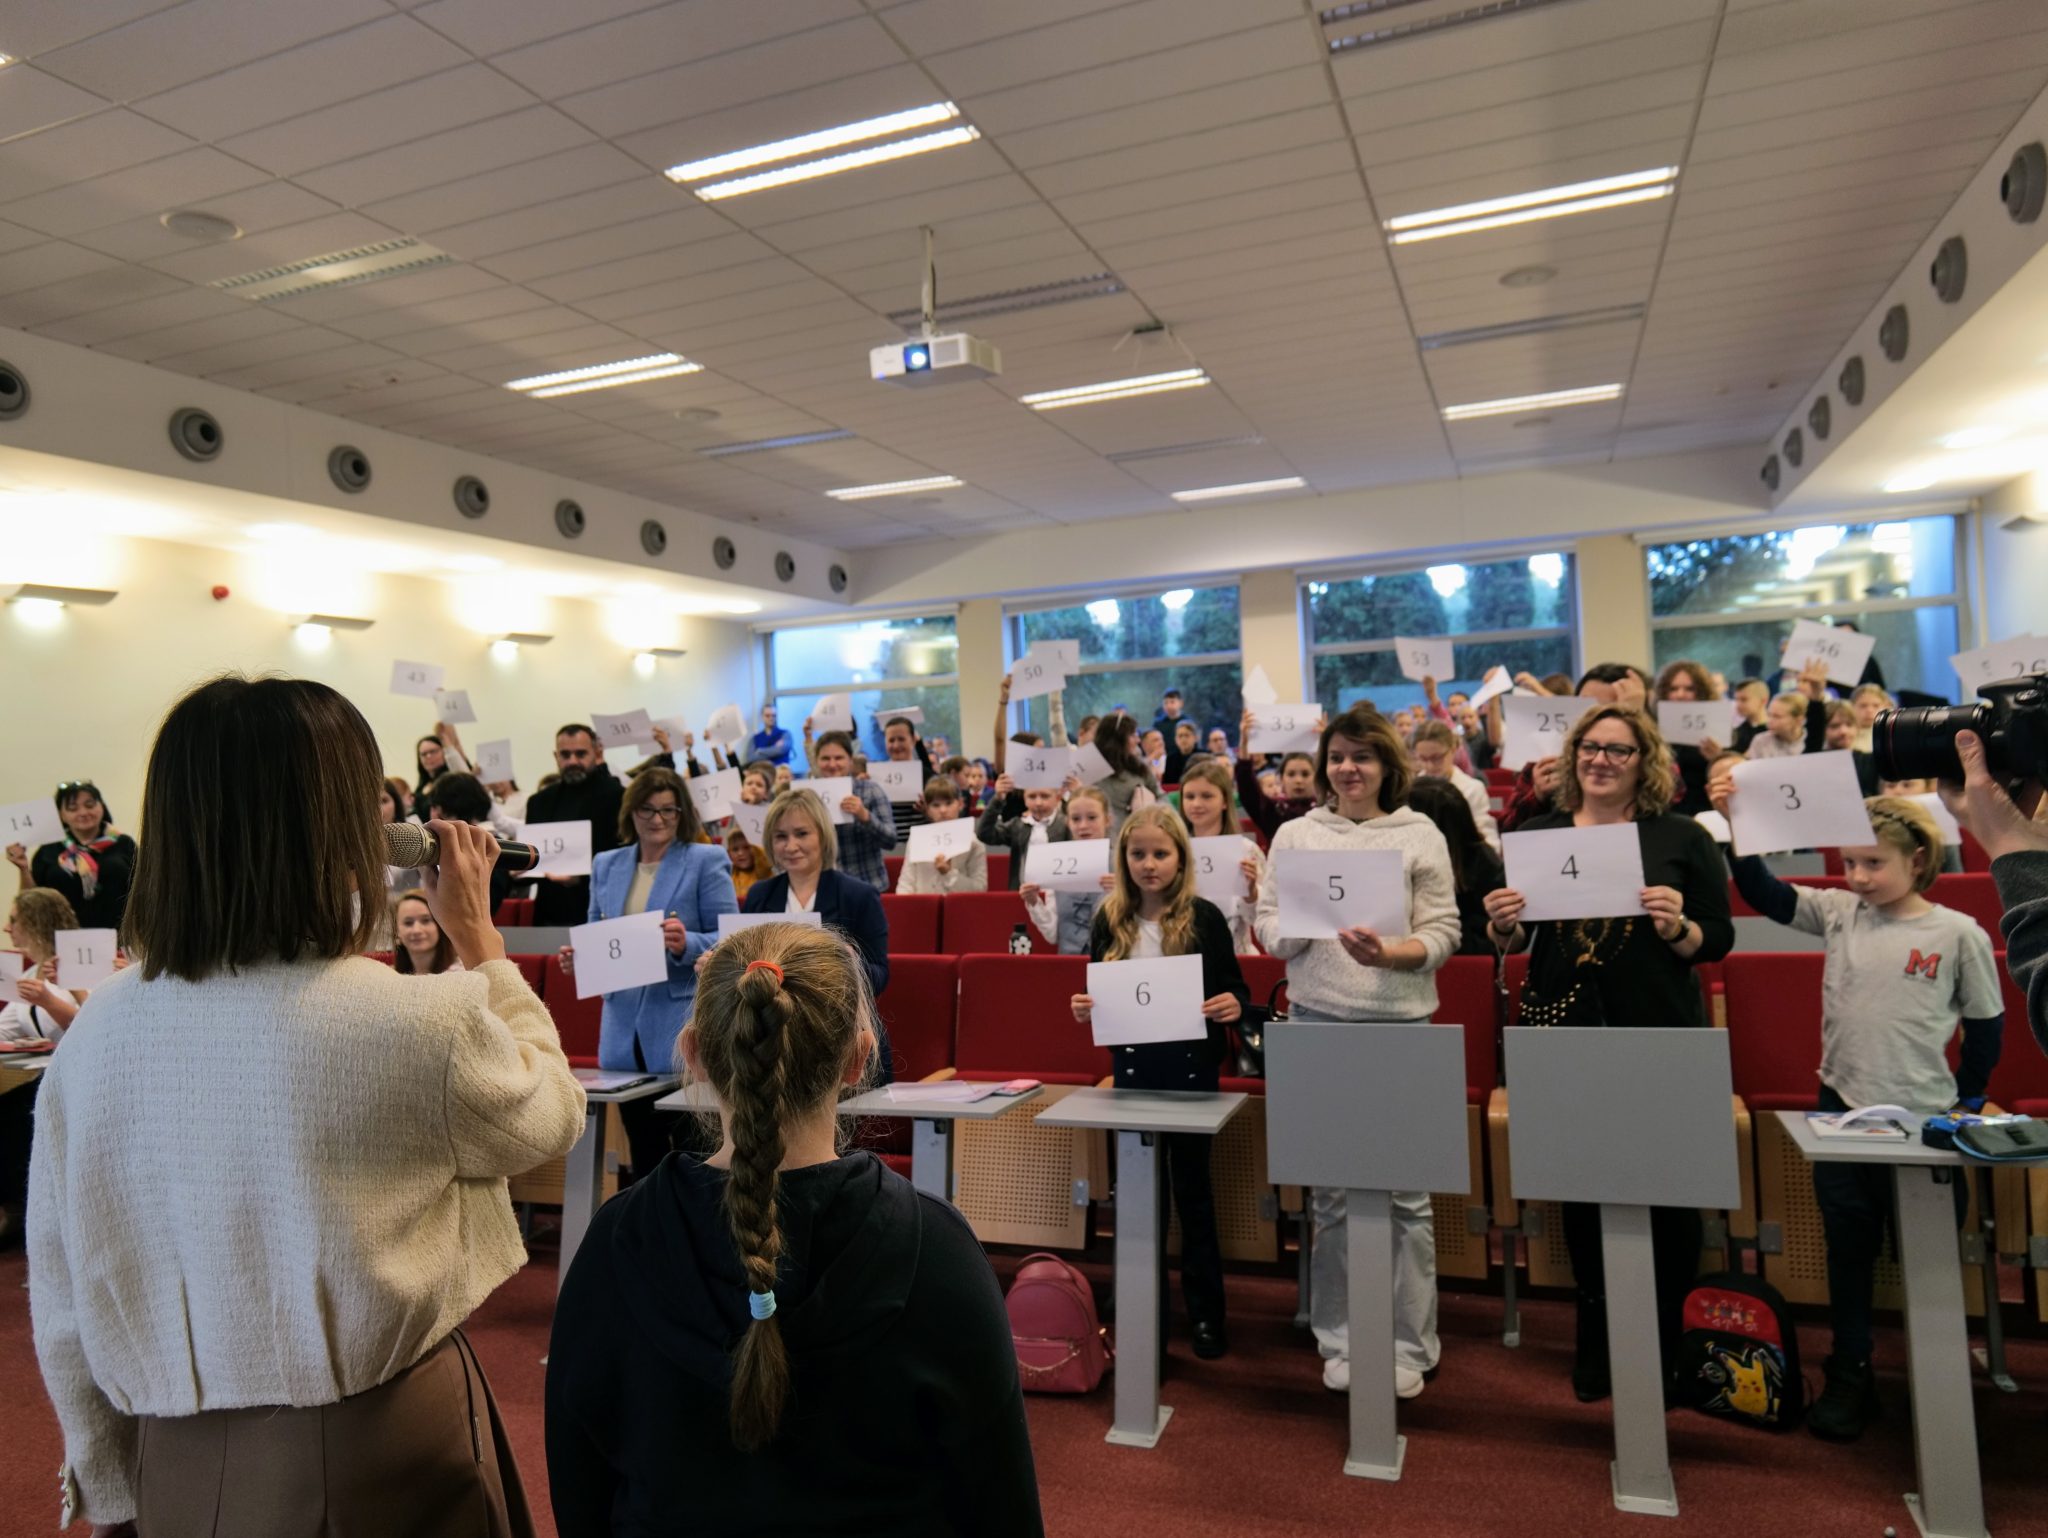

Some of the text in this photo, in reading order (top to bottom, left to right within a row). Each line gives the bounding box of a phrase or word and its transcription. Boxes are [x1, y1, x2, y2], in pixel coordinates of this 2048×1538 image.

[1816, 638, 1839, 658] 56
[1411, 651, 1429, 667] 53
[1024, 664, 1042, 681] 50
[610, 722, 631, 736] 38
[1271, 716, 1295, 731] 33
[1537, 712, 1568, 731] 25
[1682, 714, 1706, 730] 55
[1023, 758, 1046, 773] 34
[885, 773, 903, 785] 49
[700, 786, 719, 802] 37
[1779, 783, 1801, 811] 3
[11, 815, 32, 831] 14
[751, 819, 761, 833] 2
[542, 838, 564, 854] 19
[932, 833, 952, 847] 35
[1052, 857, 1078, 875] 22
[1561, 854, 1580, 880] 4
[1329, 875, 1344, 901] 5
[77, 948, 93, 964] 11
[609, 938, 622, 960] 8
[1904, 949, 1942, 980] M
[1136, 982, 1151, 1006] 6
